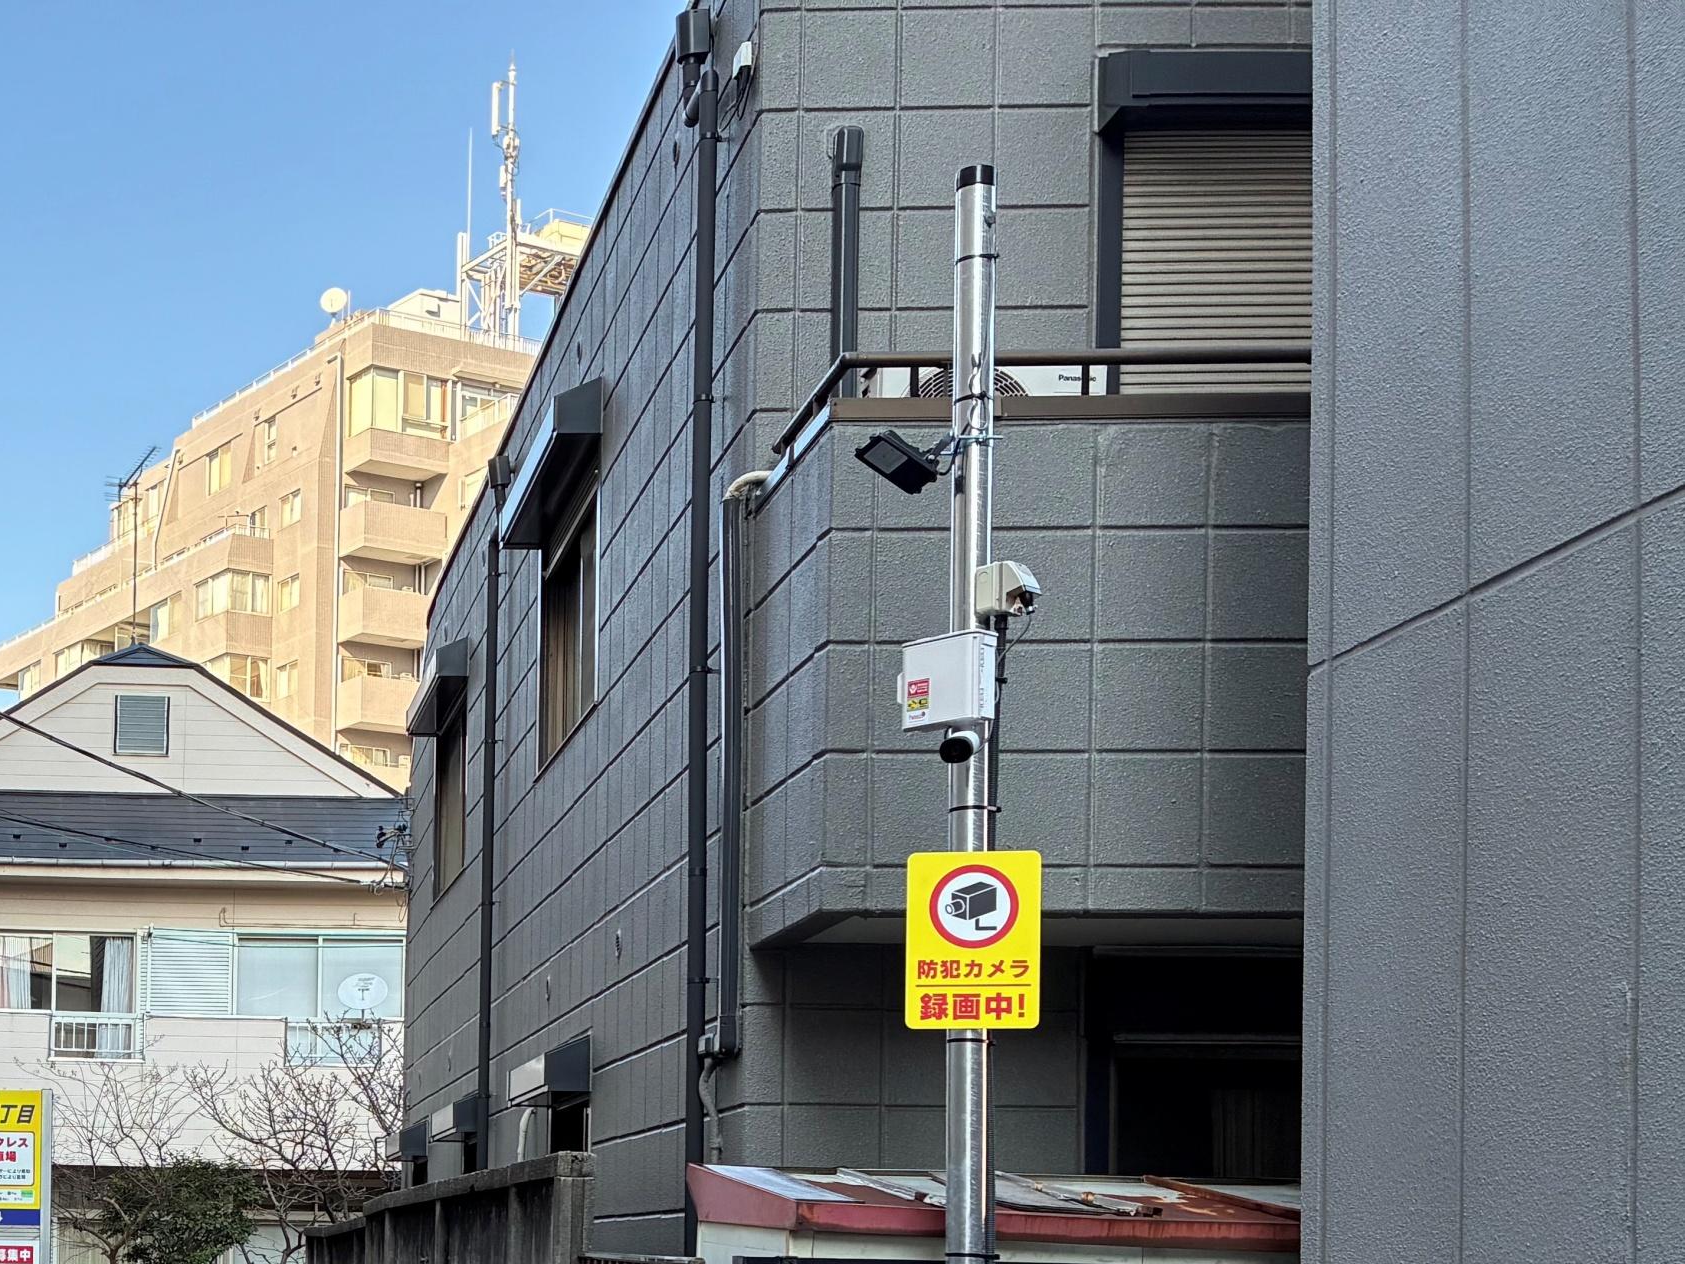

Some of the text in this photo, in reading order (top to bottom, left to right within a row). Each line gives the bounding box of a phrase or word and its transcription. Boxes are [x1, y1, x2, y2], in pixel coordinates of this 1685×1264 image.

[917, 959, 1030, 980] 防犯カメラ
[919, 992, 1026, 1021] 録画中!
